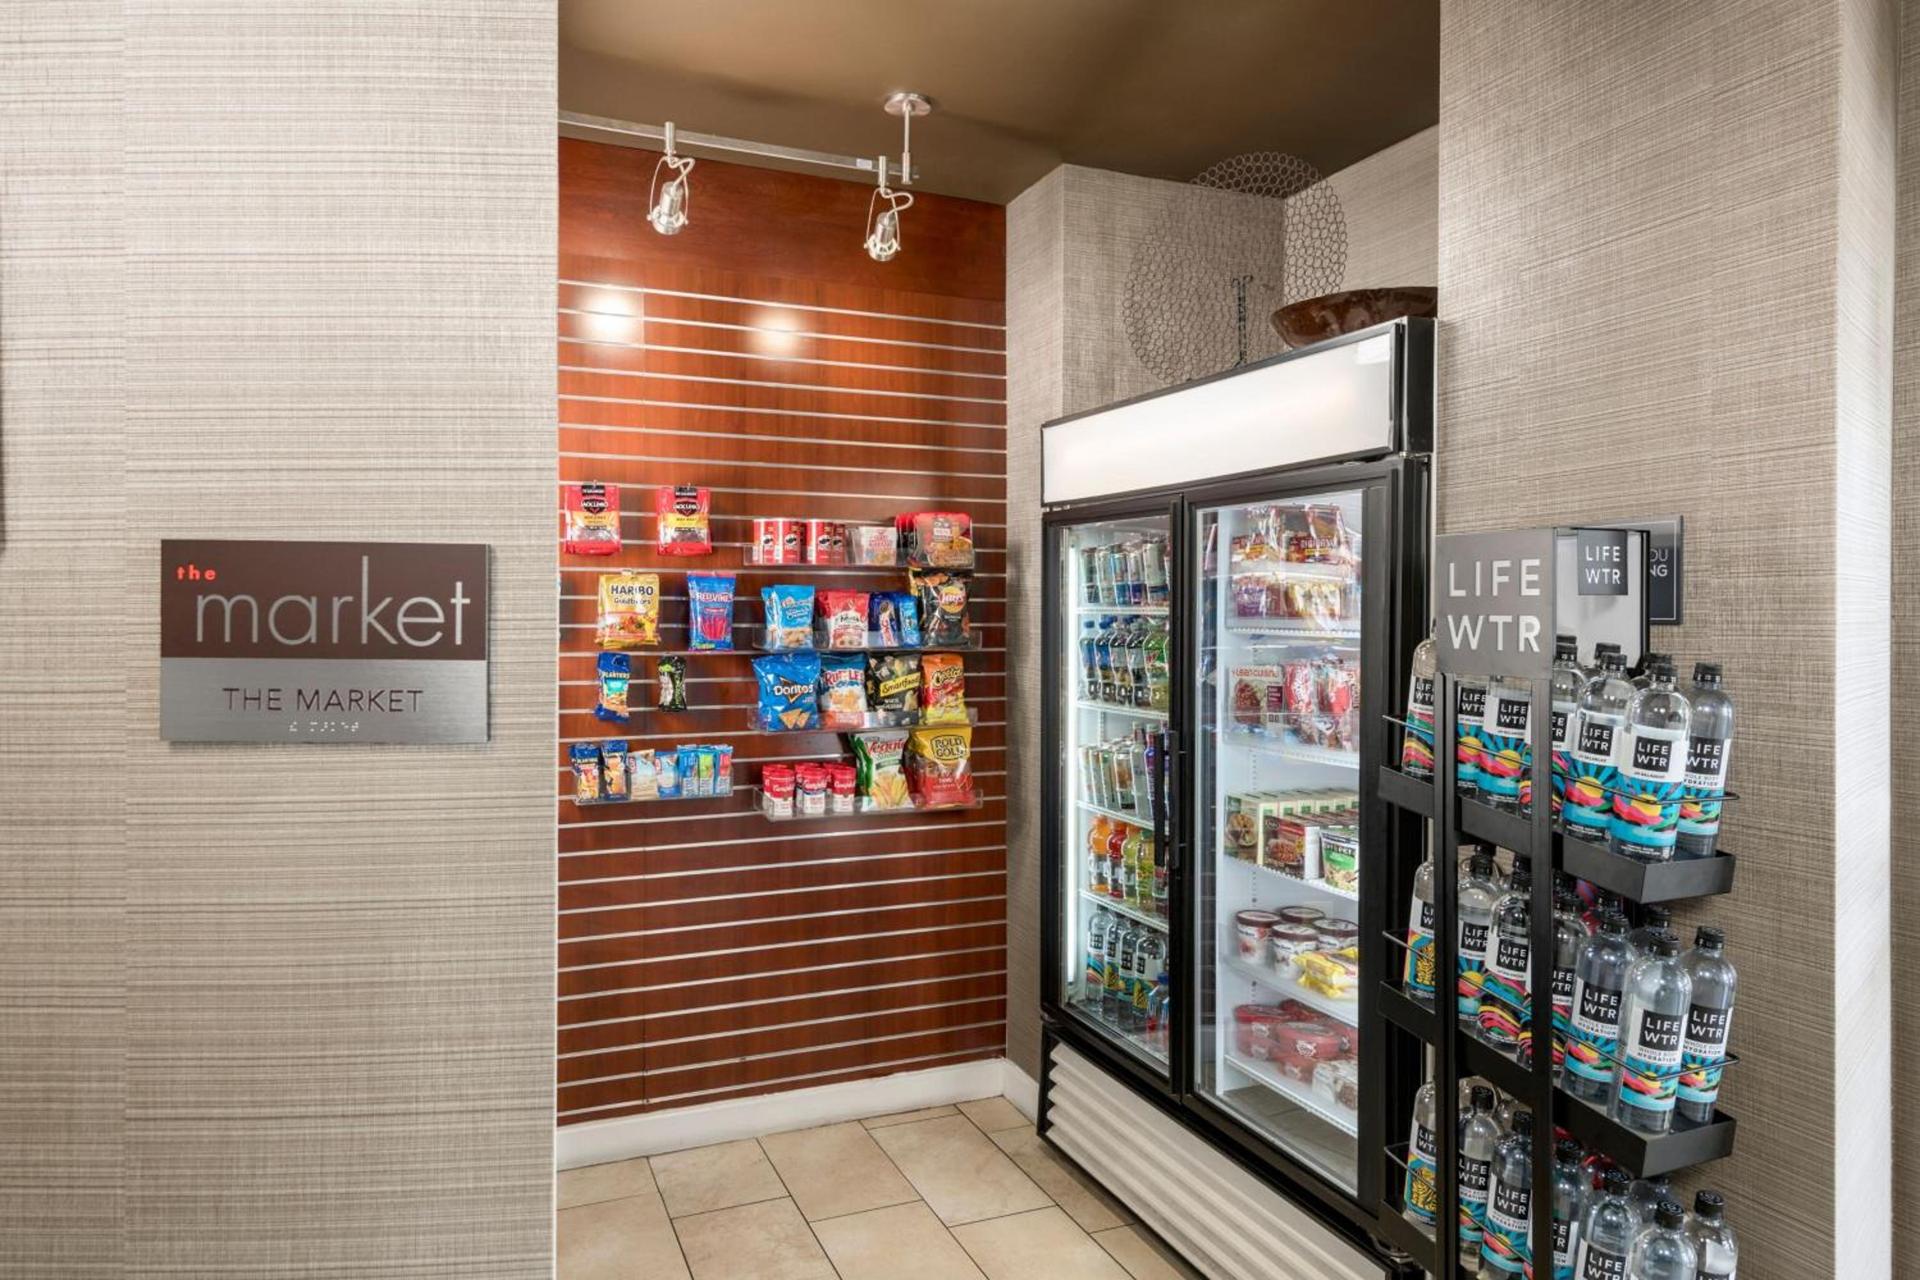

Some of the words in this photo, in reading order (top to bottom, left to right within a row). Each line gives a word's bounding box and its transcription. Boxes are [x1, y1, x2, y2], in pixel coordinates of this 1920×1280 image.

[1585, 545, 1621, 562] LIFE
[177, 564, 216, 581] the
[1449, 558, 1541, 597] LIFE
[1585, 568, 1621, 585] WTR
[611, 585, 654, 596] HARIBO
[196, 555, 471, 647] market
[1447, 614, 1541, 652] WTR
[824, 669, 864, 686] RUFLES
[773, 684, 813, 696] Doritos
[882, 675, 920, 694] Smartfood
[1415, 681, 1431, 691] LIF
[222, 688, 282, 711] THE
[296, 688, 424, 712] MARKET
[1415, 691, 1434, 702] WT
[1462, 691, 1487, 703] LIFE
[1461, 702, 1485, 713] WTR
[1501, 703, 1526, 714] LIFE
[1500, 714, 1525, 725] WTR
[1552, 716, 1565, 726] FE
[1582, 728, 1610, 740] LIFE
[935, 738, 963, 749] ROLD
[1581, 738, 1609, 751] WTR
[1638, 743, 1669, 755] LIFE
[1636, 754, 1668, 767] WTR
[1686, 756, 1719, 769] WTR
[1423, 906, 1434, 915] LI
[1464, 927, 1488, 937] LIFE
[1463, 937, 1488, 948] WTR
[1501, 945, 1527, 957] LIFE
[1500, 955, 1525, 967] WTR
[1553, 970, 1573, 981] IFE
[1585, 988, 1619, 1006] LIFE
[1583, 1000, 1617, 1019] WTR
[1693, 1010, 1725, 1025] LIFE
[1646, 1017, 1680, 1032] LIFE
[1691, 1023, 1723, 1039] WTR
[1644, 1030, 1678, 1045] WTR
[1419, 1129, 1434, 1140] LIF
[1419, 1139, 1436, 1152] WT
[1459, 1158, 1488, 1175] LIFE
[1458, 1171, 1486, 1186] WTR
[1498, 1185, 1528, 1204] LIFE
[1497, 1196, 1527, 1215] WTR
[1590, 1252, 1622, 1272] LIFE
